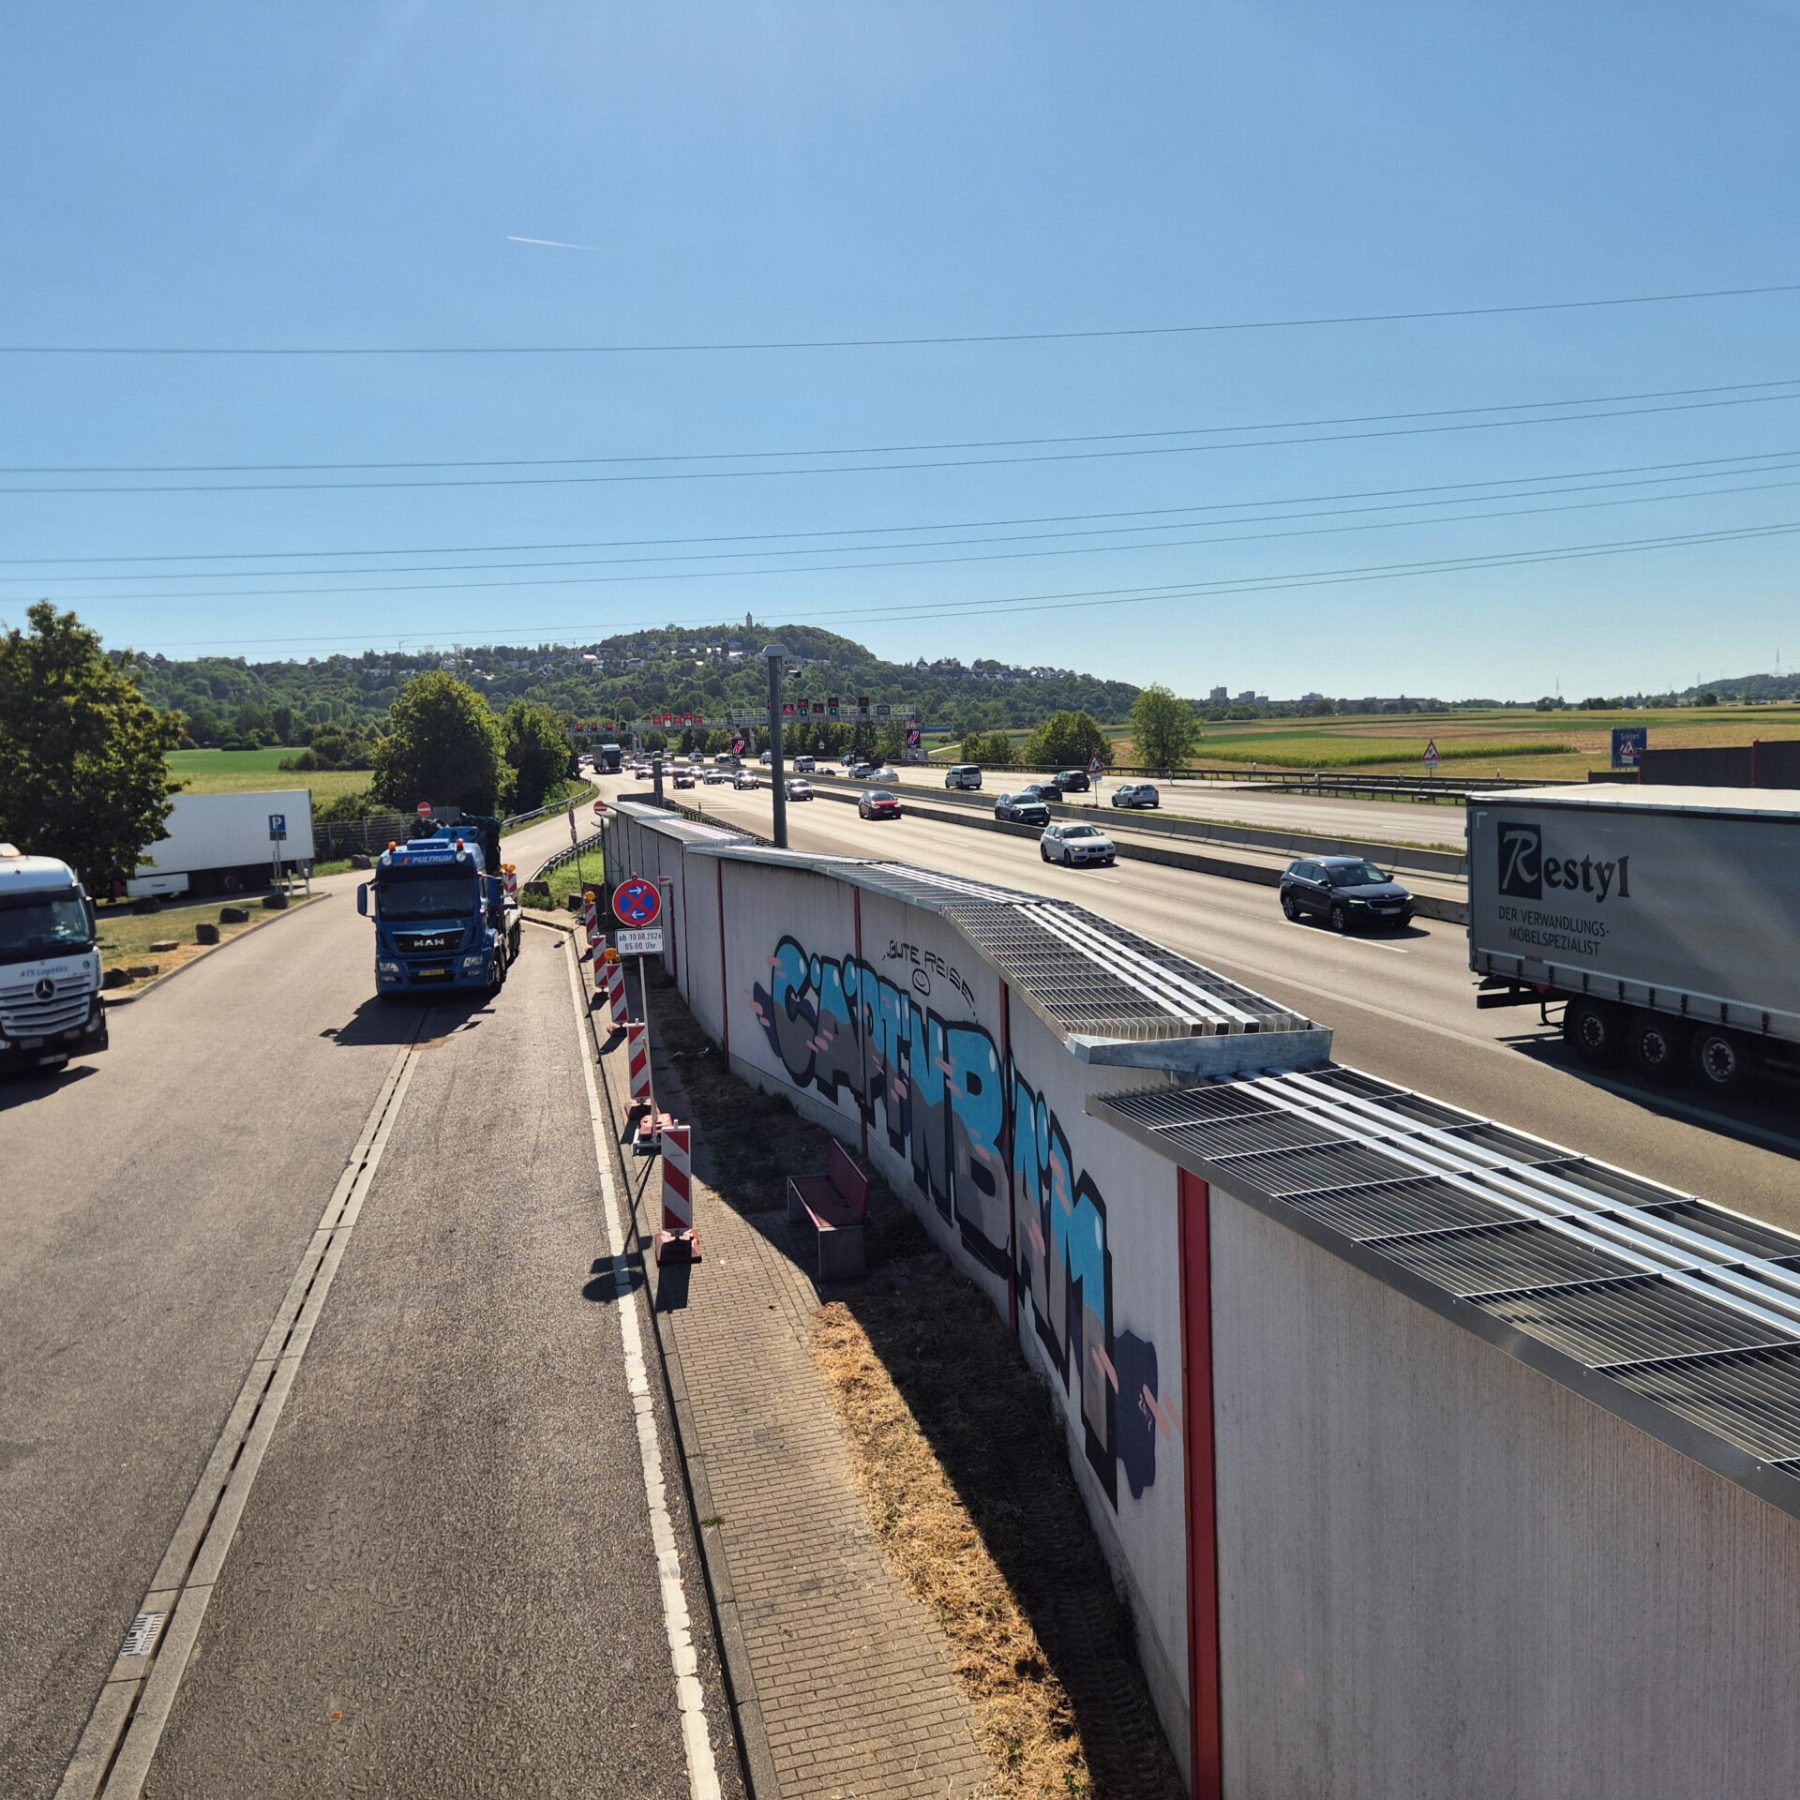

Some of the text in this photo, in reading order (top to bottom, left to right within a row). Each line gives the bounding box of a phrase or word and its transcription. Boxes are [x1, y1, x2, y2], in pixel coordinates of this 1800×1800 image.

[272, 816, 282, 830] P
[412, 854, 452, 864] PULTRUM
[1503, 830, 1630, 903] Restyl
[1498, 906, 1610, 937] DER VERWANDLUNGS-
[413, 938, 445, 947] MAN
[645, 941, 656, 950] Uhr
[19, 966, 68, 978] ATS Logistics
